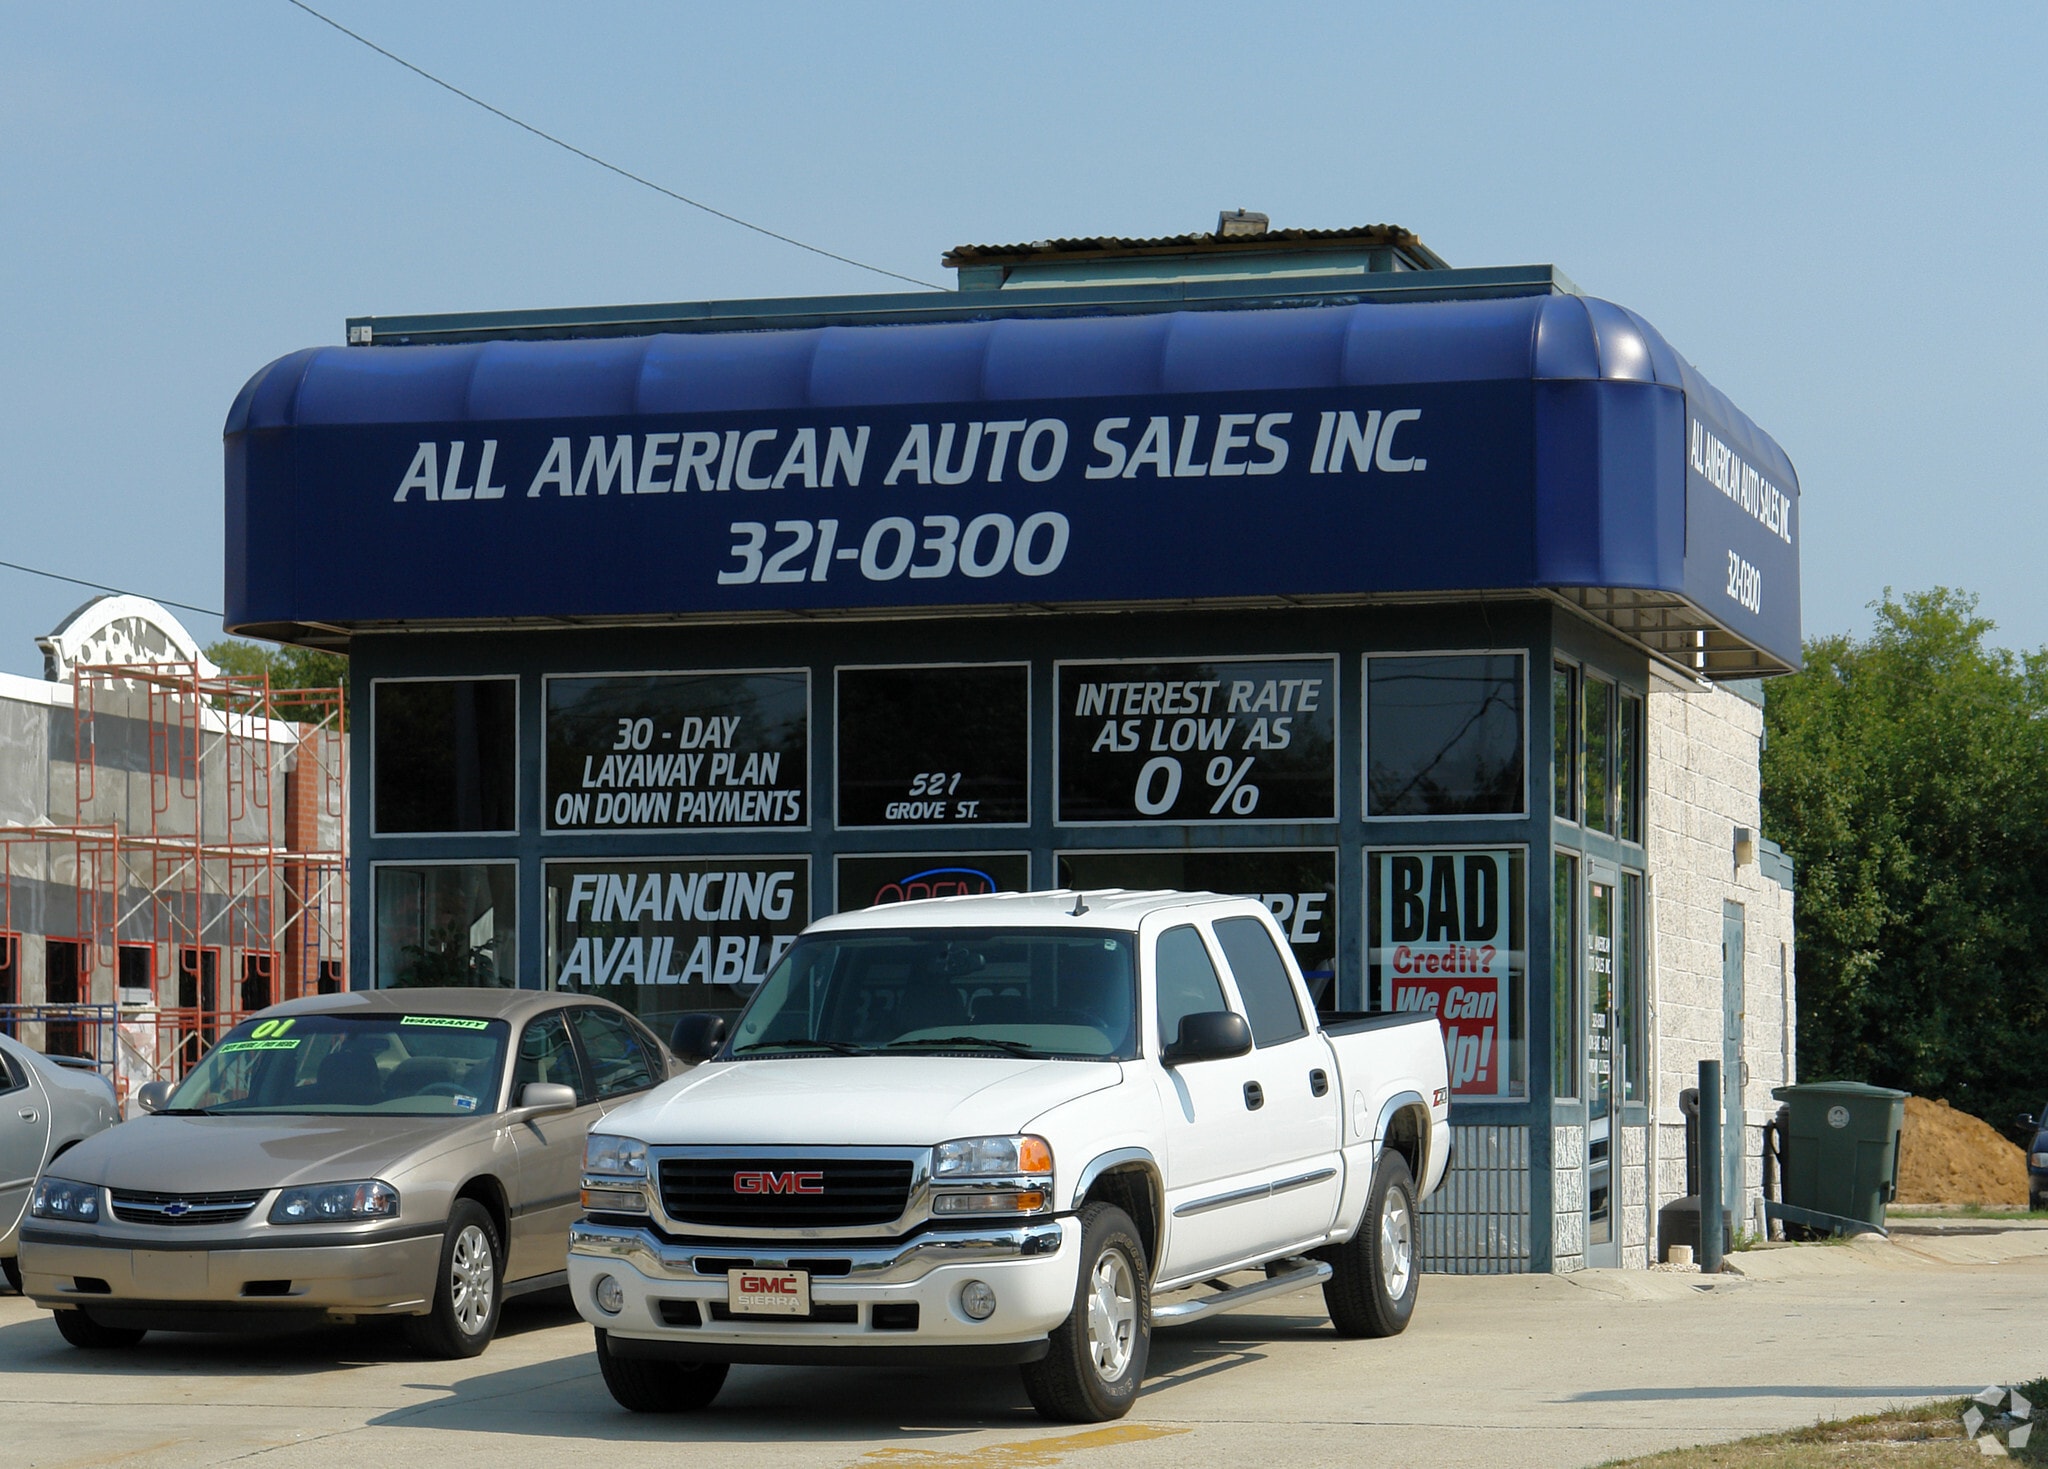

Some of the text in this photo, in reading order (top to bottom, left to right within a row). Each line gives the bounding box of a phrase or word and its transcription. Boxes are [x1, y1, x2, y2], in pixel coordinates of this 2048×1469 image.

[393, 408, 1428, 502] ALL AMERICAN AUTO SALES INC.
[1690, 418, 1704, 475] ALL
[1704, 431, 1741, 504] AMERICAN
[1740, 461, 1760, 519] AUTO
[1760, 477, 1780, 534] SALES
[717, 511, 1070, 585] 321-0300
[1726, 549, 1761, 615] 321-0300
[1075, 679, 1323, 716] INTEREST RATE
[613, 718, 653, 750] 30
[679, 716, 741, 749] DAY
[1092, 717, 1292, 752] AS LOW AS
[582, 752, 780, 788] LAYAWAY PLAN
[908, 772, 962, 796] 521
[1134, 756, 1260, 816] 0 %
[554, 790, 801, 825] ON DOWN PAYMENTS
[885, 801, 980, 819] GROVE ST.
[566, 871, 795, 923] FINANCING
[1391, 855, 1499, 943] BAD
[1393, 944, 1497, 975] Credit?
[1397, 986, 1497, 1020] We Can
[251, 1019, 296, 1039] 01
[403, 1018, 485, 1027] WARRANTY
[733, 1171, 824, 1194] GMC
[738, 1295, 800, 1306] SIERRA
[740, 1276, 797, 1294] GMC
